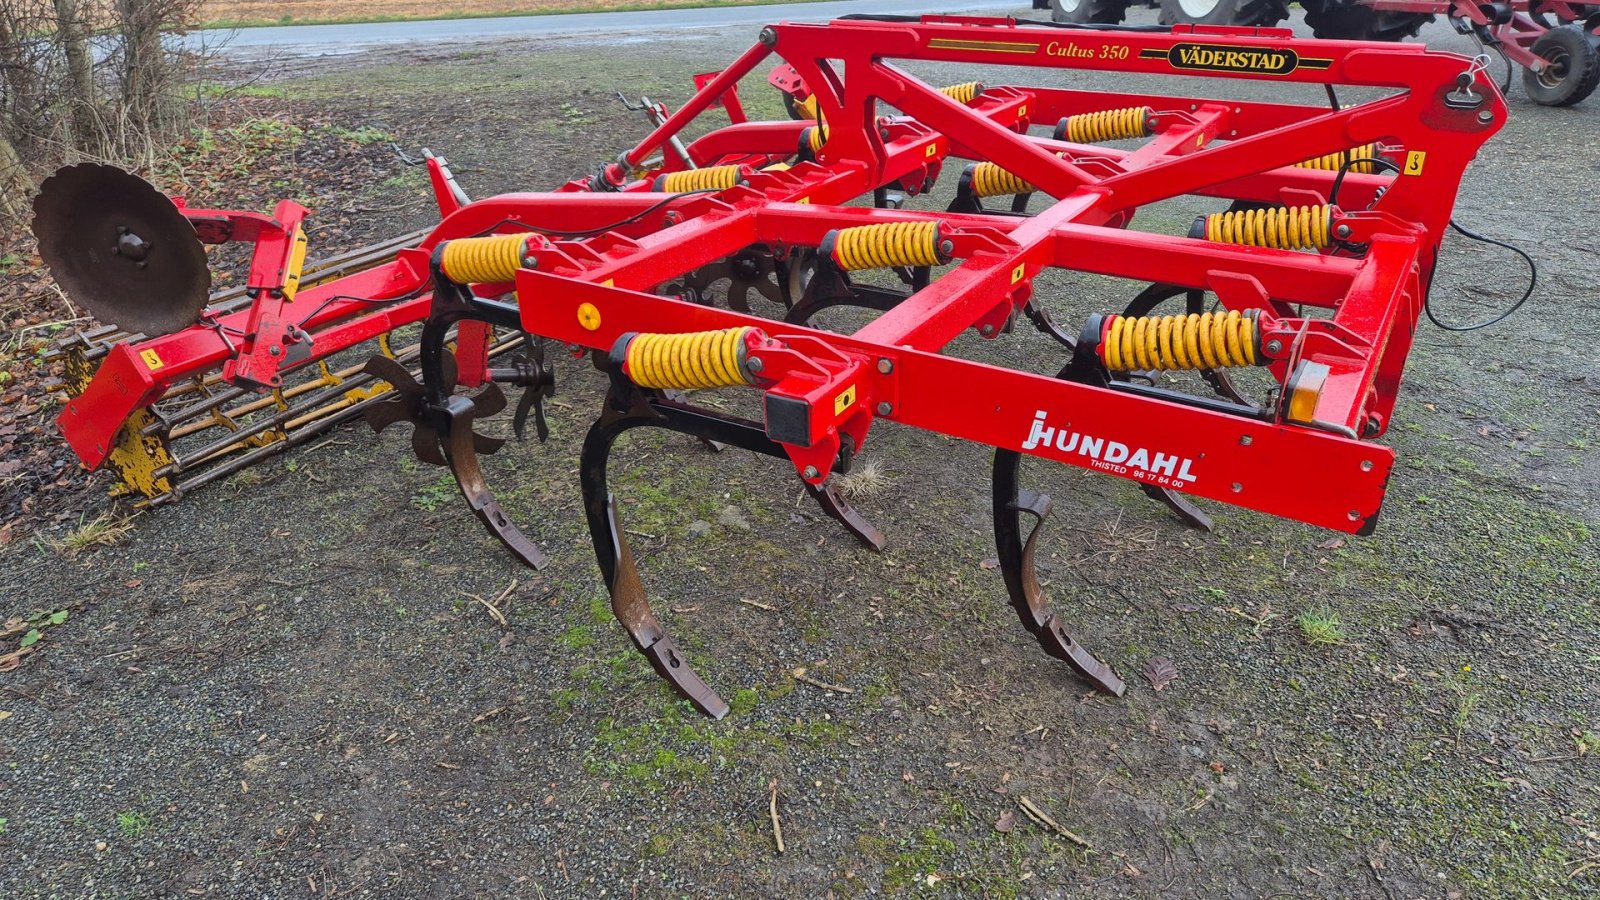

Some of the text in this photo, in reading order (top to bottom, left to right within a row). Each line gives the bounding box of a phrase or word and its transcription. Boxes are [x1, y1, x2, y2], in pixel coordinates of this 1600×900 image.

[1046, 42, 1129, 60] Cultus 350
[1180, 45, 1285, 70] VÄDERSTAD
[1091, 459, 1184, 488] THISTED 96 17 84 00
